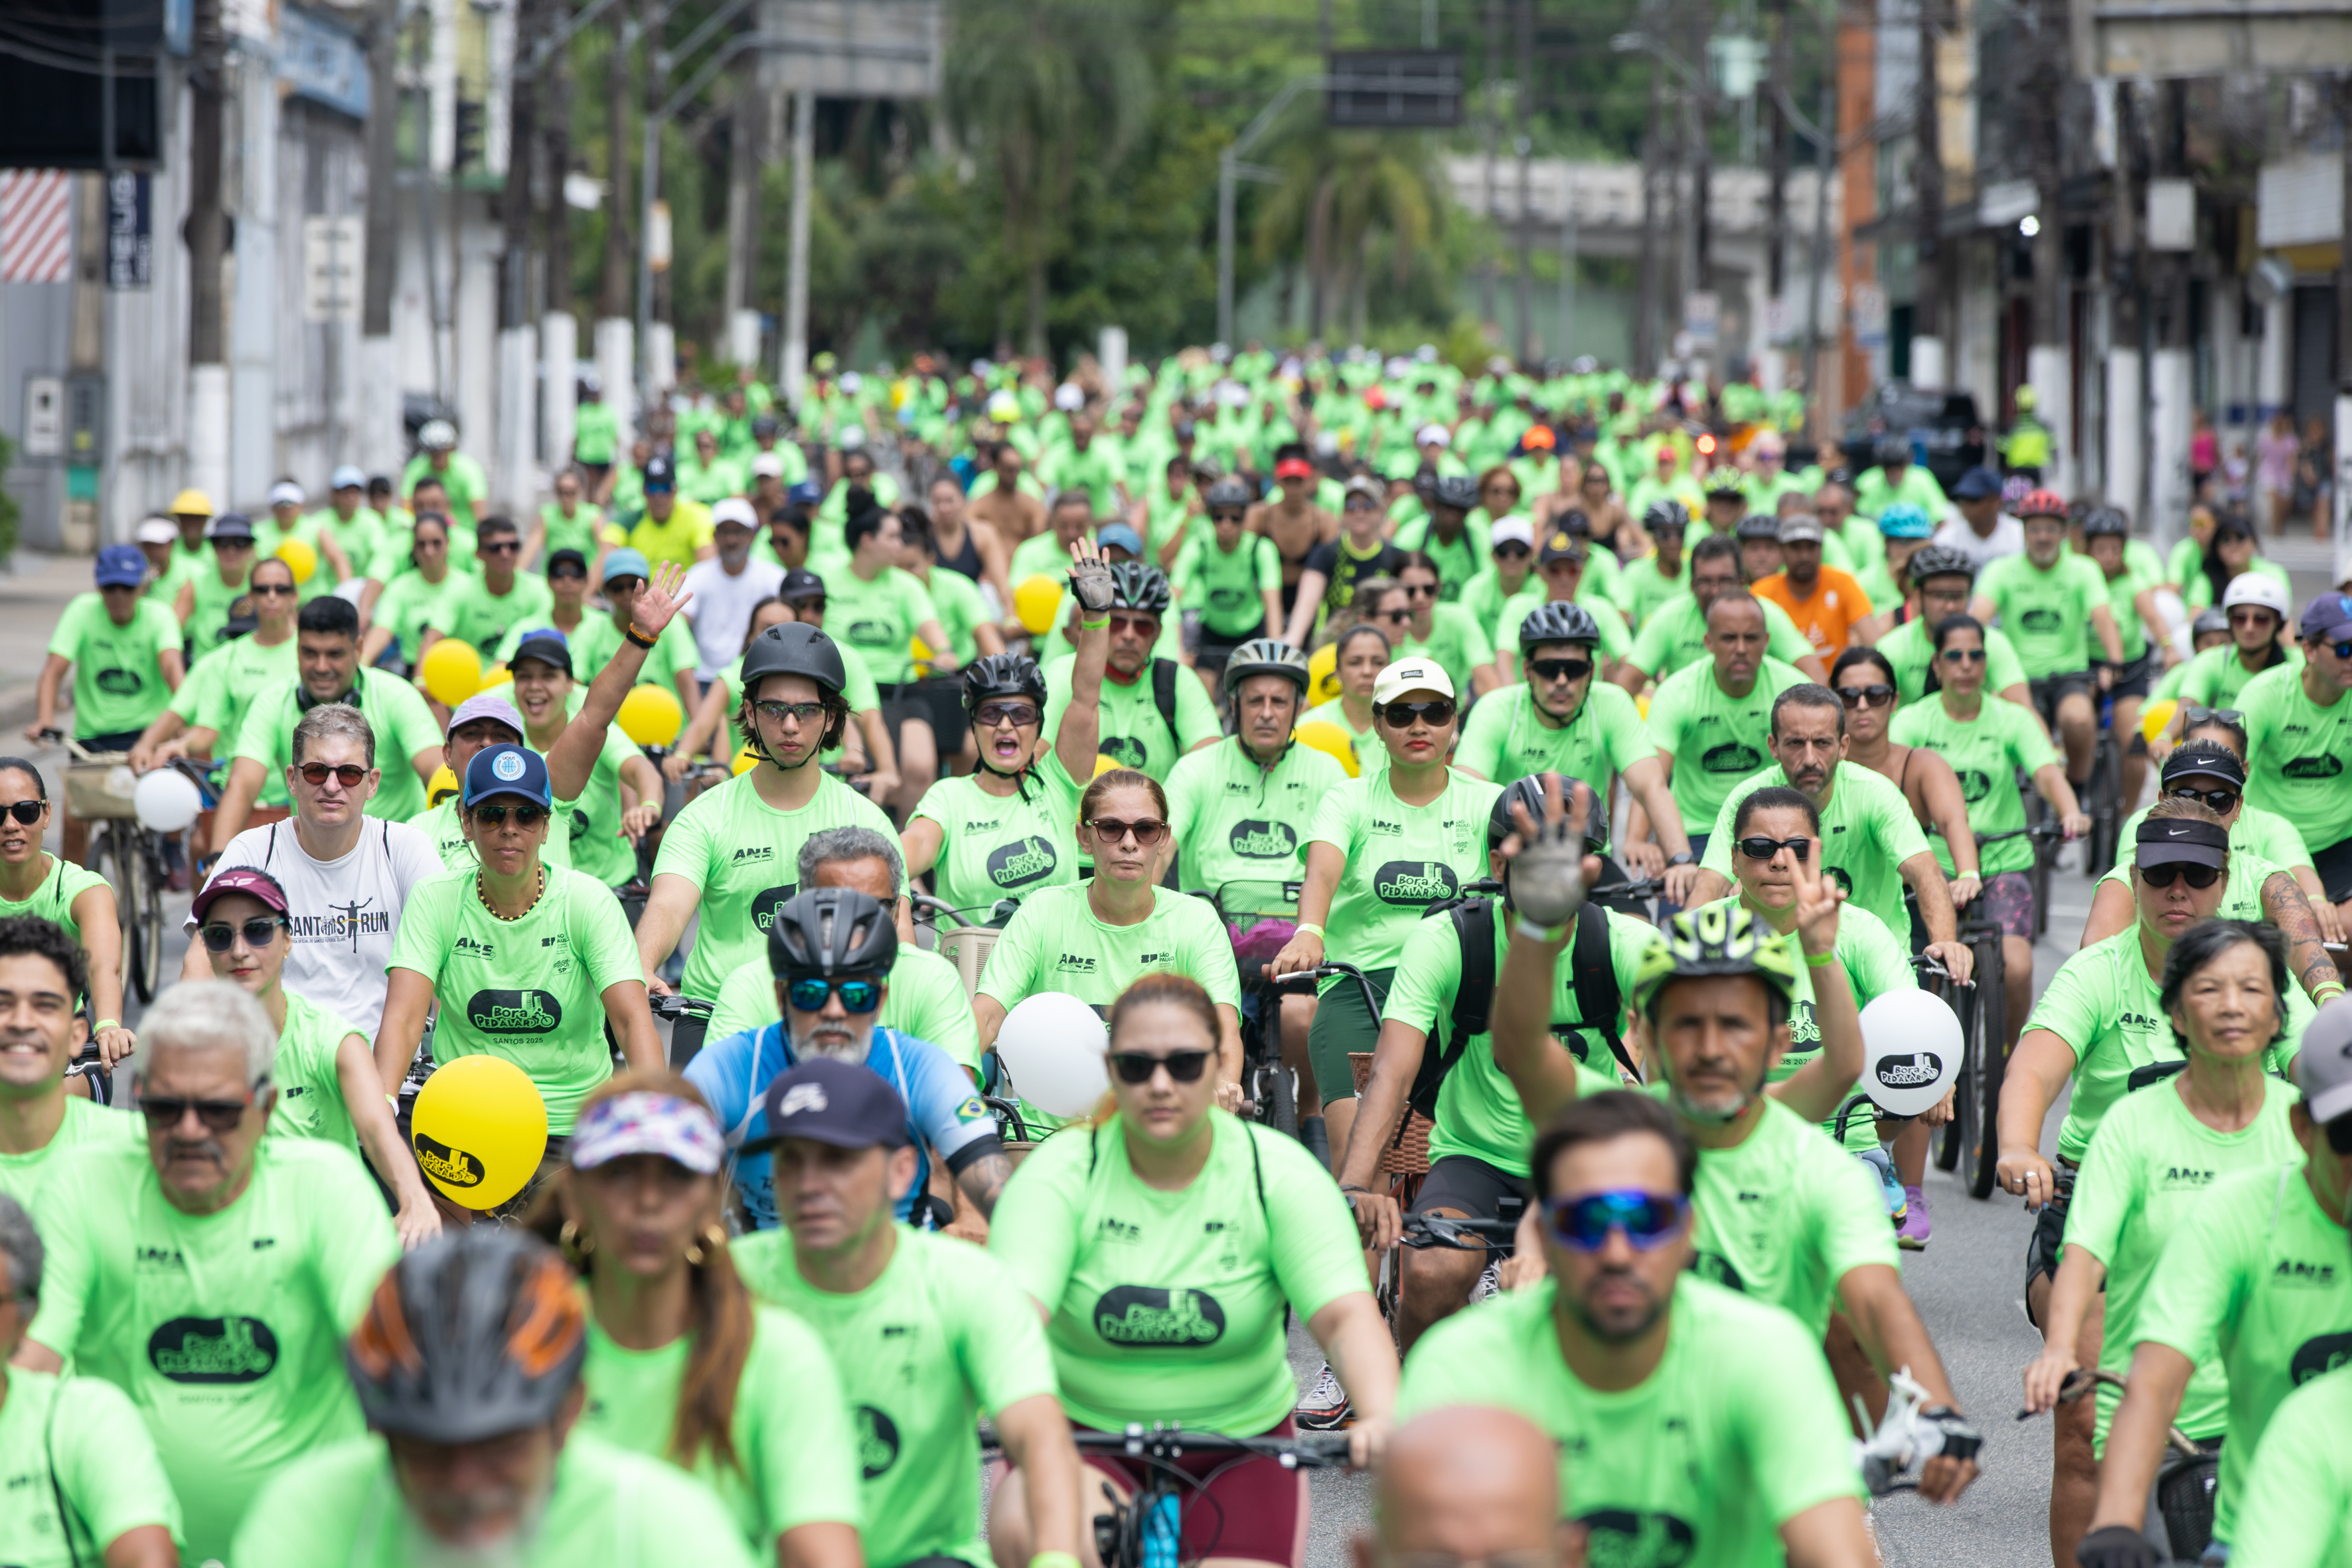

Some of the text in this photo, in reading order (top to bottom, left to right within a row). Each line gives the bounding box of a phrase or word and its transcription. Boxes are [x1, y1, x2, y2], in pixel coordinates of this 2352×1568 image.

[1007, 853, 1034, 866] Bora
[996, 862, 1038, 882] PEDALAR
[1399, 875, 1428, 886] Bora
[1381, 884, 1429, 897] PEDALAR
[360, 911, 389, 933] RUN
[493, 1006, 528, 1018] Bora
[475, 1015, 531, 1028] PEDALAR
[1881, 1073, 1921, 1083] PEDALAR
[418, 1151, 457, 1180] PEDALAR
[428, 1152, 453, 1170] Bora
